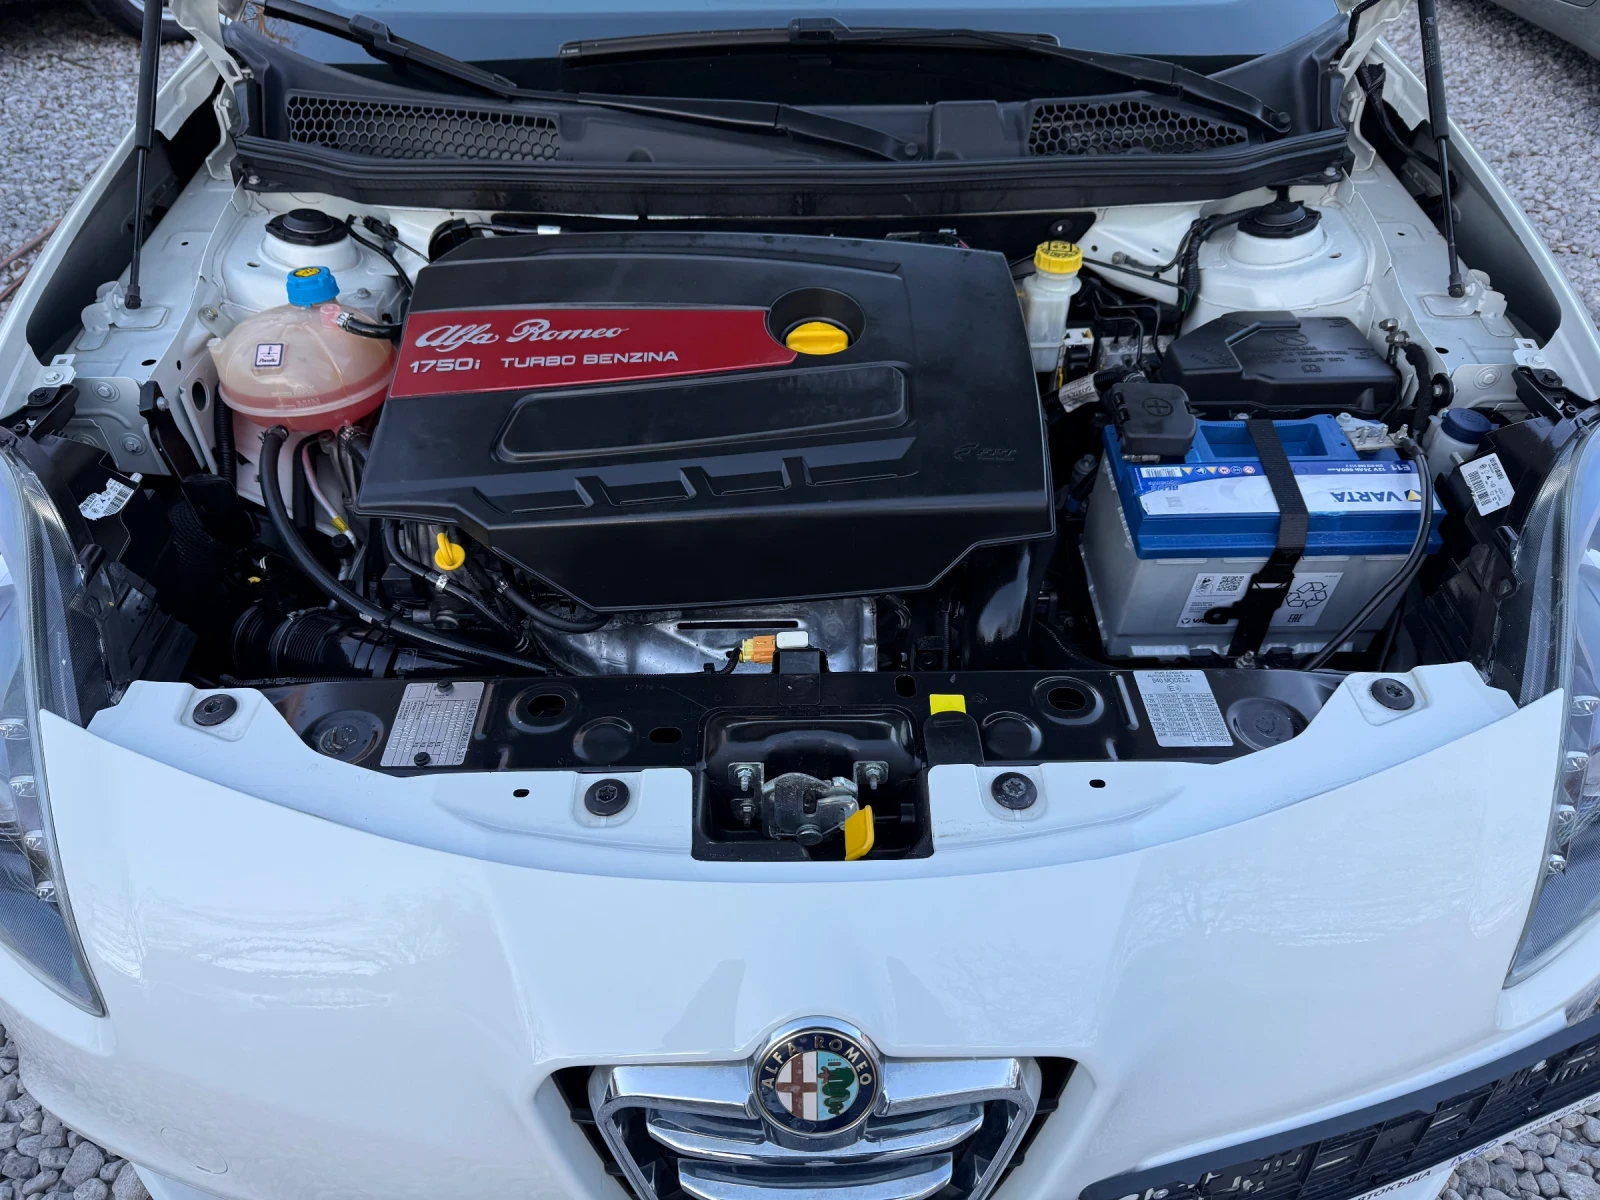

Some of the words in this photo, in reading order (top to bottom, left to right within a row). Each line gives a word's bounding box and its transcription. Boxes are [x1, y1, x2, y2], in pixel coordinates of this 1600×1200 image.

[415, 322, 500, 353] Alfa
[506, 318, 630, 344] Romeo
[409, 357, 480, 374] 1750i
[501, 353, 577, 369] TURBO
[582, 350, 679, 365] BENZINA
[296, 397, 321, 408] MIN
[1329, 490, 1403, 503] VARTA
[761, 1042, 798, 1089] ALFA
[814, 1035, 873, 1086] ROMEO
